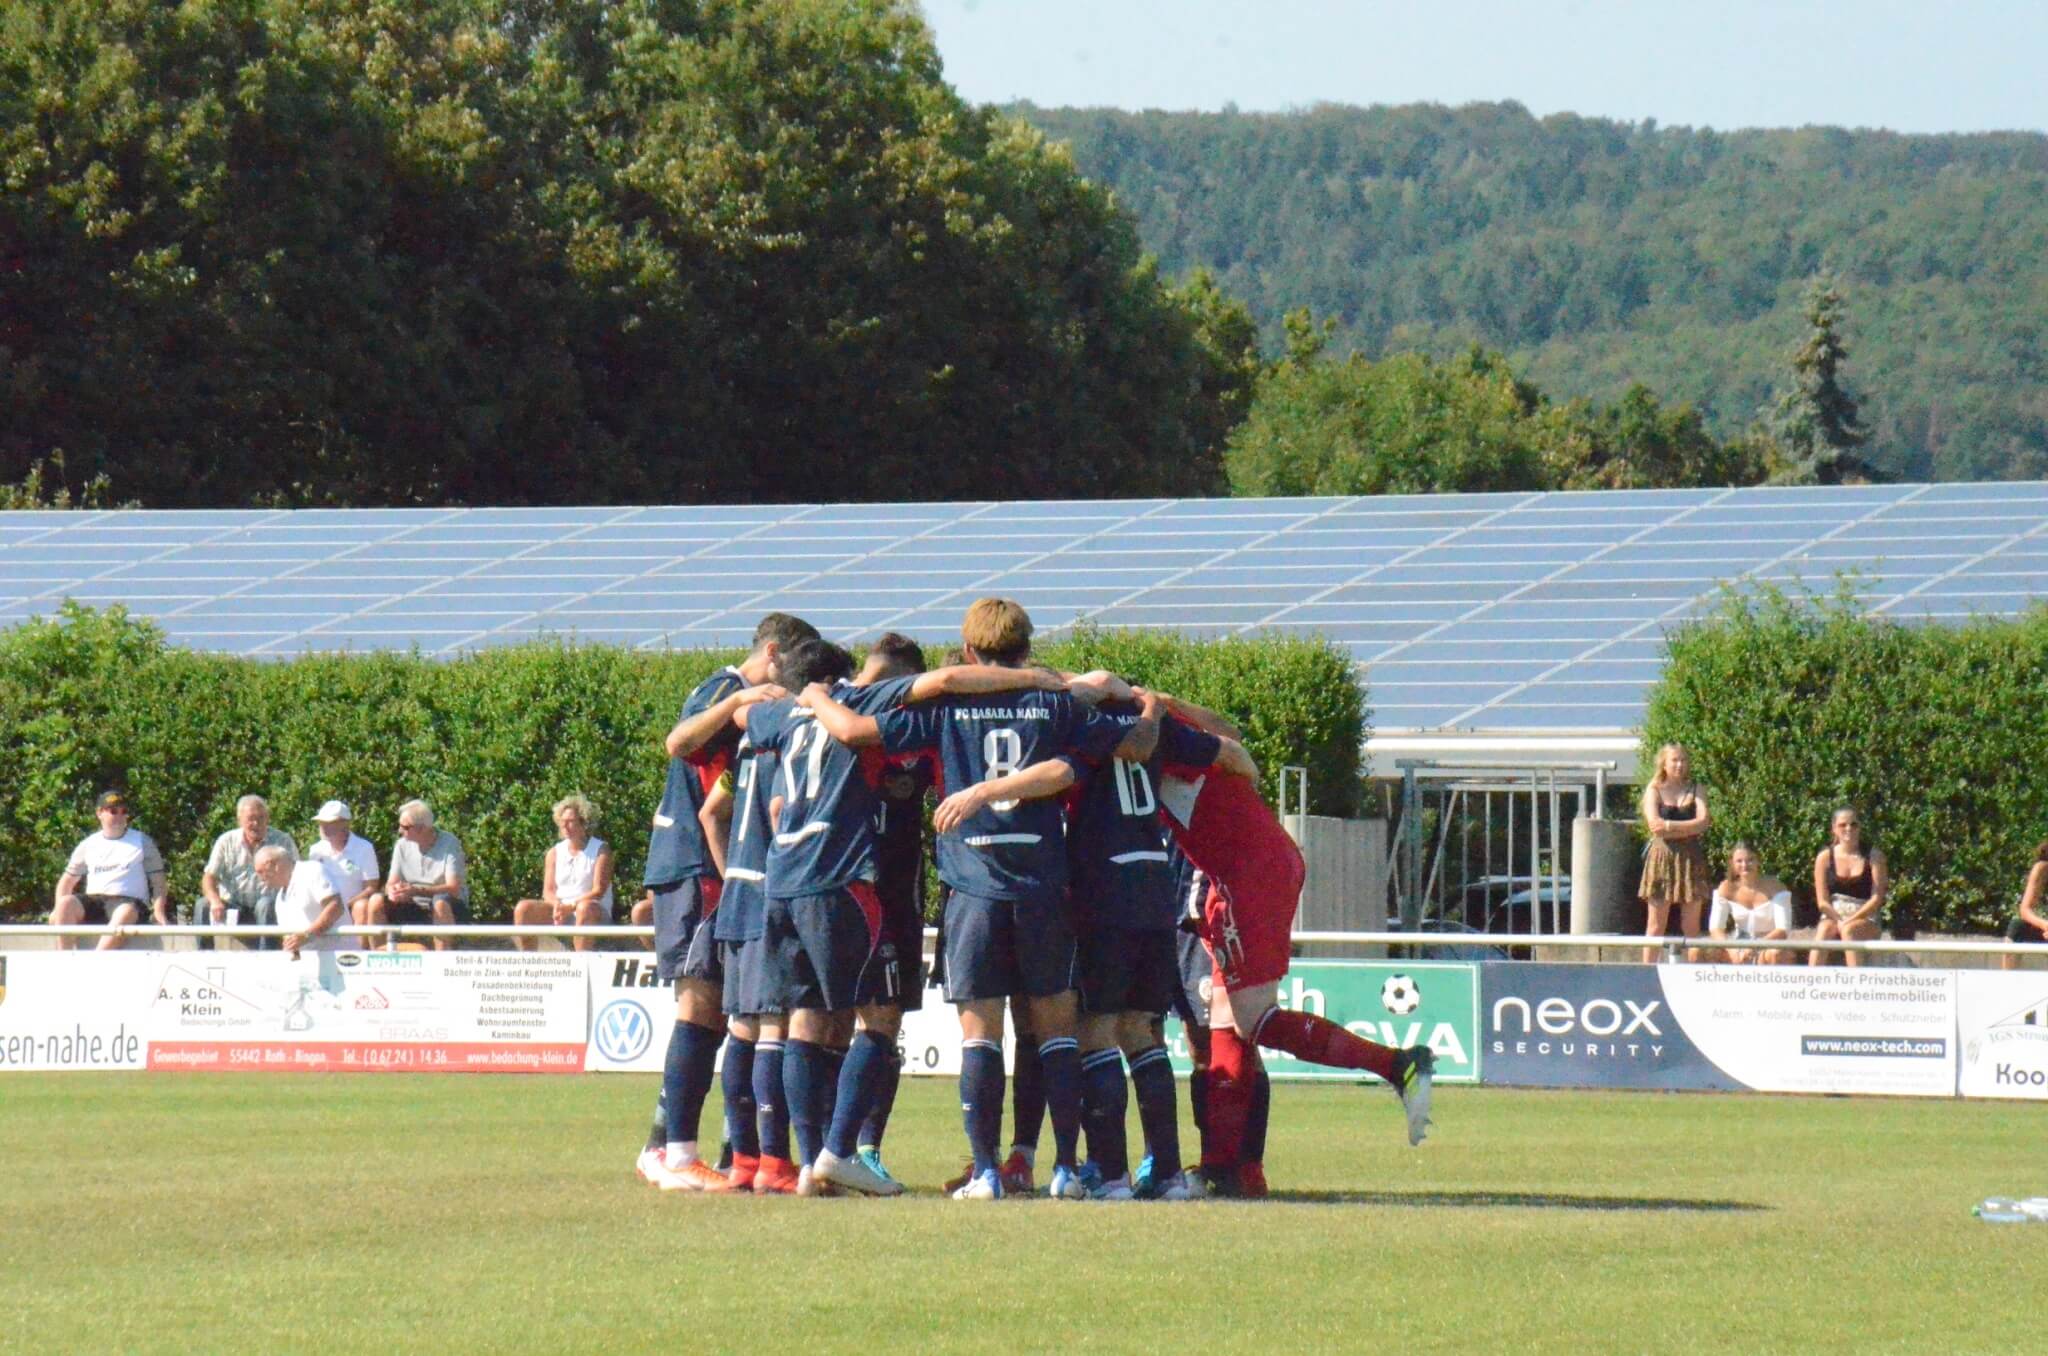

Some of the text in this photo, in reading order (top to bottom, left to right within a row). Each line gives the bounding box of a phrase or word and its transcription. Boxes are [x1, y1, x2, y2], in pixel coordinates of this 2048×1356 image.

[971, 707, 1013, 719] BASARA
[1016, 707, 1050, 719] MAINZ
[983, 728, 1021, 812] 8
[486, 955, 571, 966] Flachdachabdichtung
[444, 967, 472, 977] Dächer
[474, 968, 482, 977] in
[507, 968, 522, 977] und
[525, 968, 582, 979] Kupferstehfalz
[1694, 970, 1946, 987] Sicherheitslösungen für Privathäuser
[472, 981, 553, 991] Fassadenbekleidung
[180, 988, 190, 1000] &
[197, 987, 222, 1000] Ch.
[481, 993, 543, 1003] Dachbegrünung
[1781, 988, 1946, 1002] und Gewerbeimmobilien
[181, 1003, 222, 1015] Klein
[480, 1006, 544, 1016] Asbestsanierung
[1712, 1008, 1744, 1018] Alarm
[1757, 1009, 1793, 1020] Mobile
[1797, 1010, 1824, 1022] Apps
[1834, 1011, 1866, 1021] Video
[477, 1018, 547, 1027] Wohnraumfenster
[1493, 996, 1663, 1036] neox
[491, 1031, 531, 1040] Kaminbau
[1493, 1042, 1663, 1057] SECURITY
[1805, 1038, 1943, 1055] www.neox-tech.com
[467, 1050, 578, 1067] www.bedachung-klein.de
[1996, 1063, 2048, 1086] Koo
